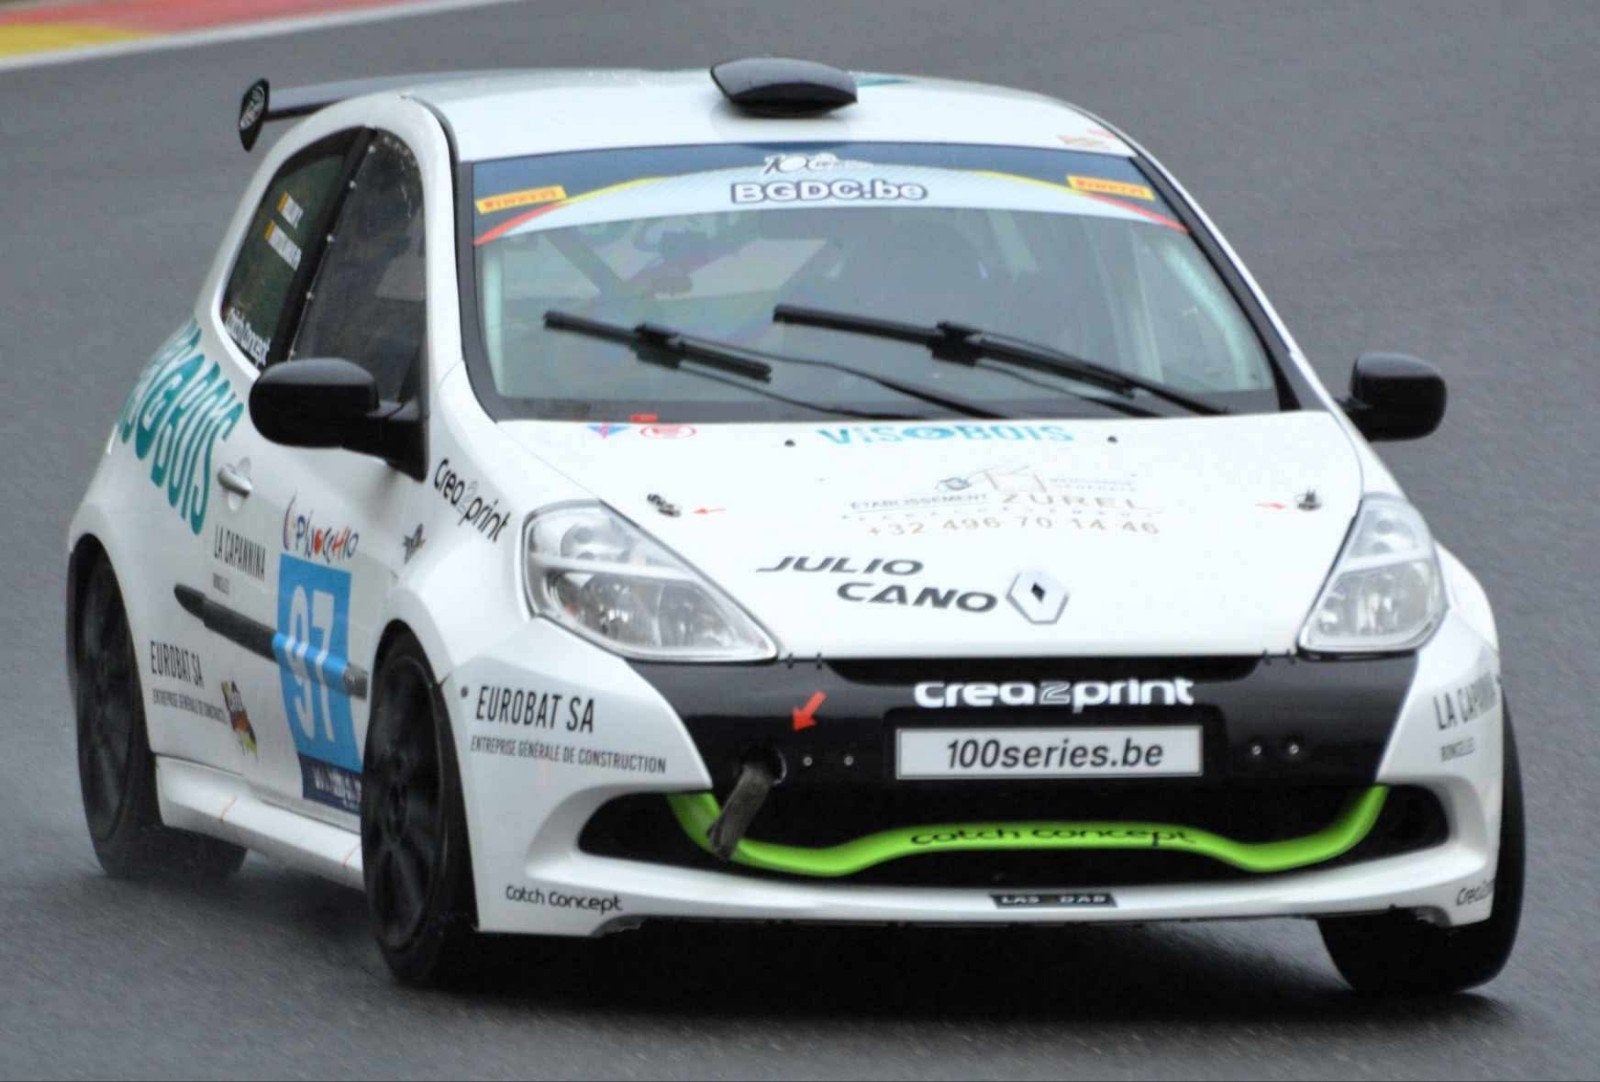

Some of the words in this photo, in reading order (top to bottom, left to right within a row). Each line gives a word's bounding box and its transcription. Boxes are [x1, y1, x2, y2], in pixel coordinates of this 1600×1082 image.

[731, 179, 928, 205] BGDC.be
[213, 523, 224, 562] LA
[756, 556, 924, 576] JULIO
[837, 582, 999, 613] CANO
[149, 639, 193, 684] EUROBAT
[285, 582, 336, 744] 97
[476, 685, 564, 730] EUROBAT
[566, 696, 595, 733] SA
[470, 734, 517, 757] ENTREPRISE
[562, 746, 576, 764] DE
[577, 748, 667, 774] CONSTRUCTION
[946, 737, 1164, 769] 100series.be
[505, 884, 546, 906] Catch
[548, 890, 624, 915] Concept
